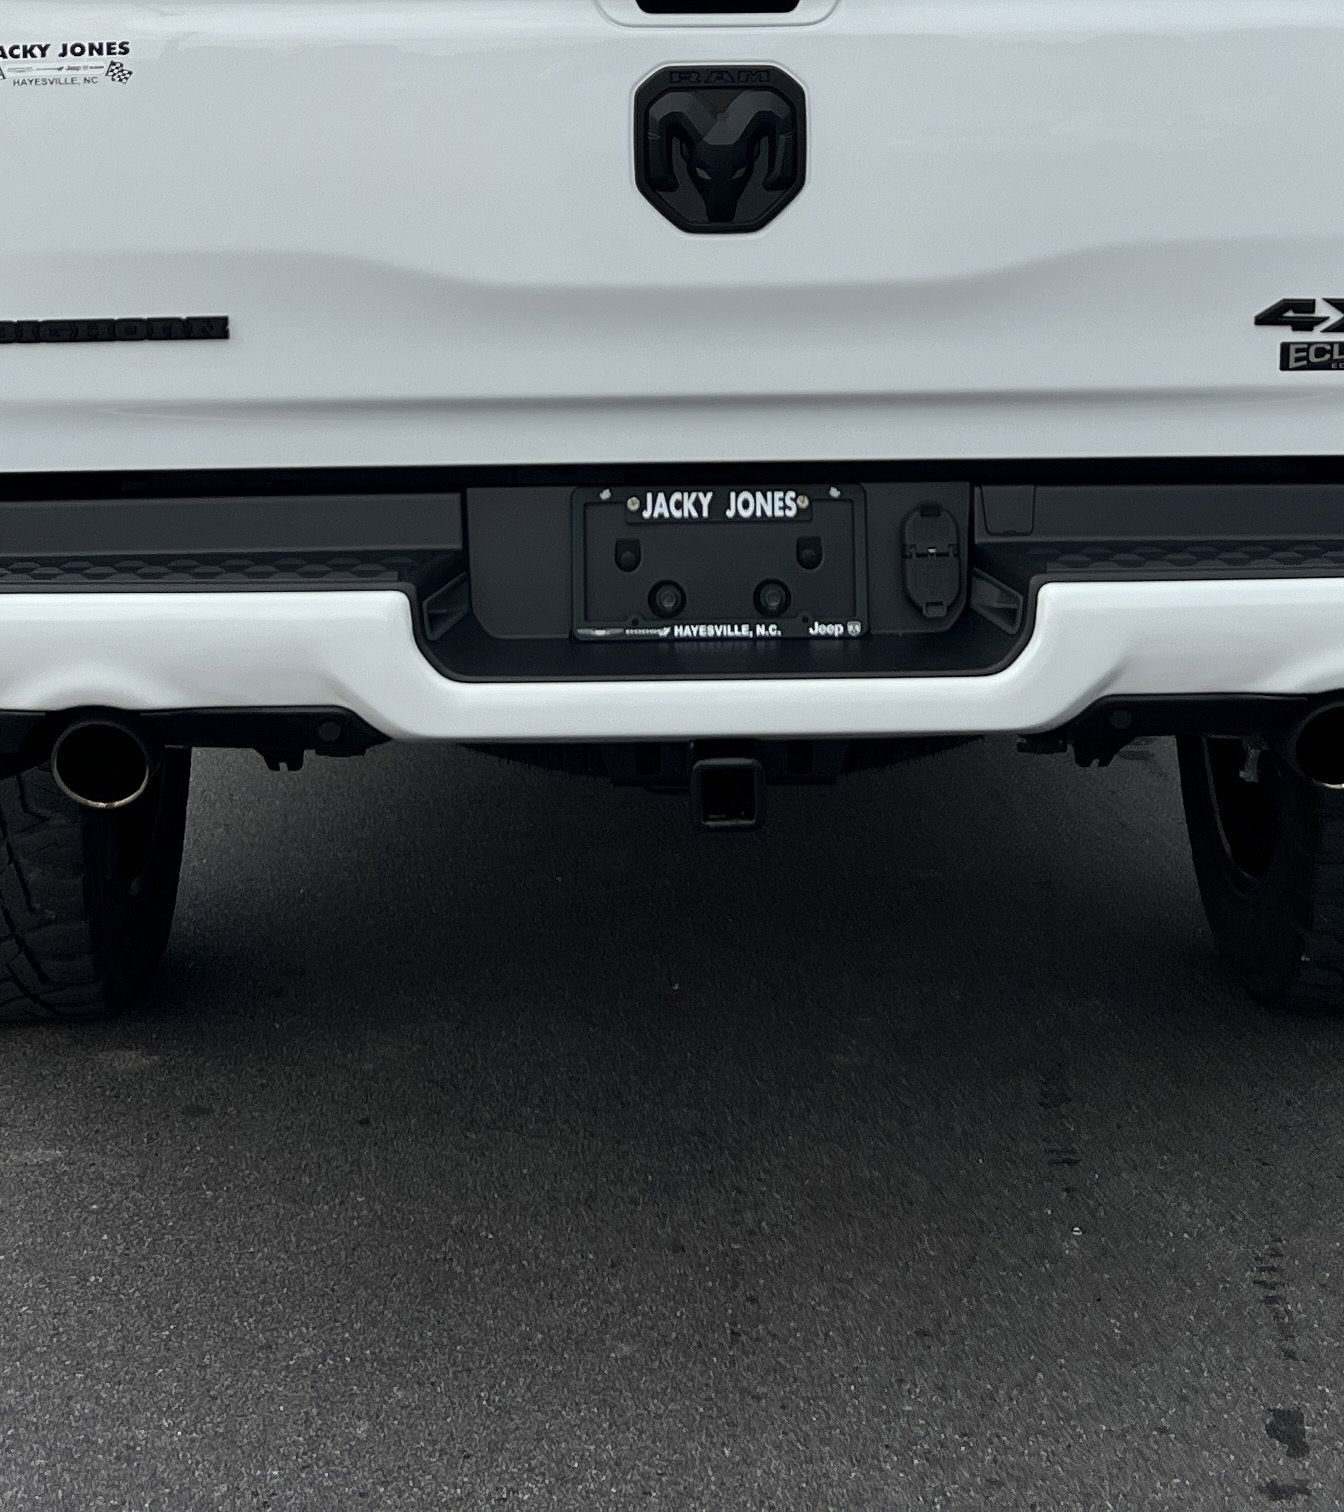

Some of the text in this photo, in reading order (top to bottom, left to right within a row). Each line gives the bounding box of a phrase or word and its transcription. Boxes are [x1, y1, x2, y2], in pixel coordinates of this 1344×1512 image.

[58, 41, 130, 58] JONES
[670, 70, 771, 83] RAM
[642, 490, 798, 519] JACKY JONES
[674, 624, 753, 638] HAYESVILLE,
[756, 624, 782, 637] N.C.
[809, 621, 844, 637] Jeep
